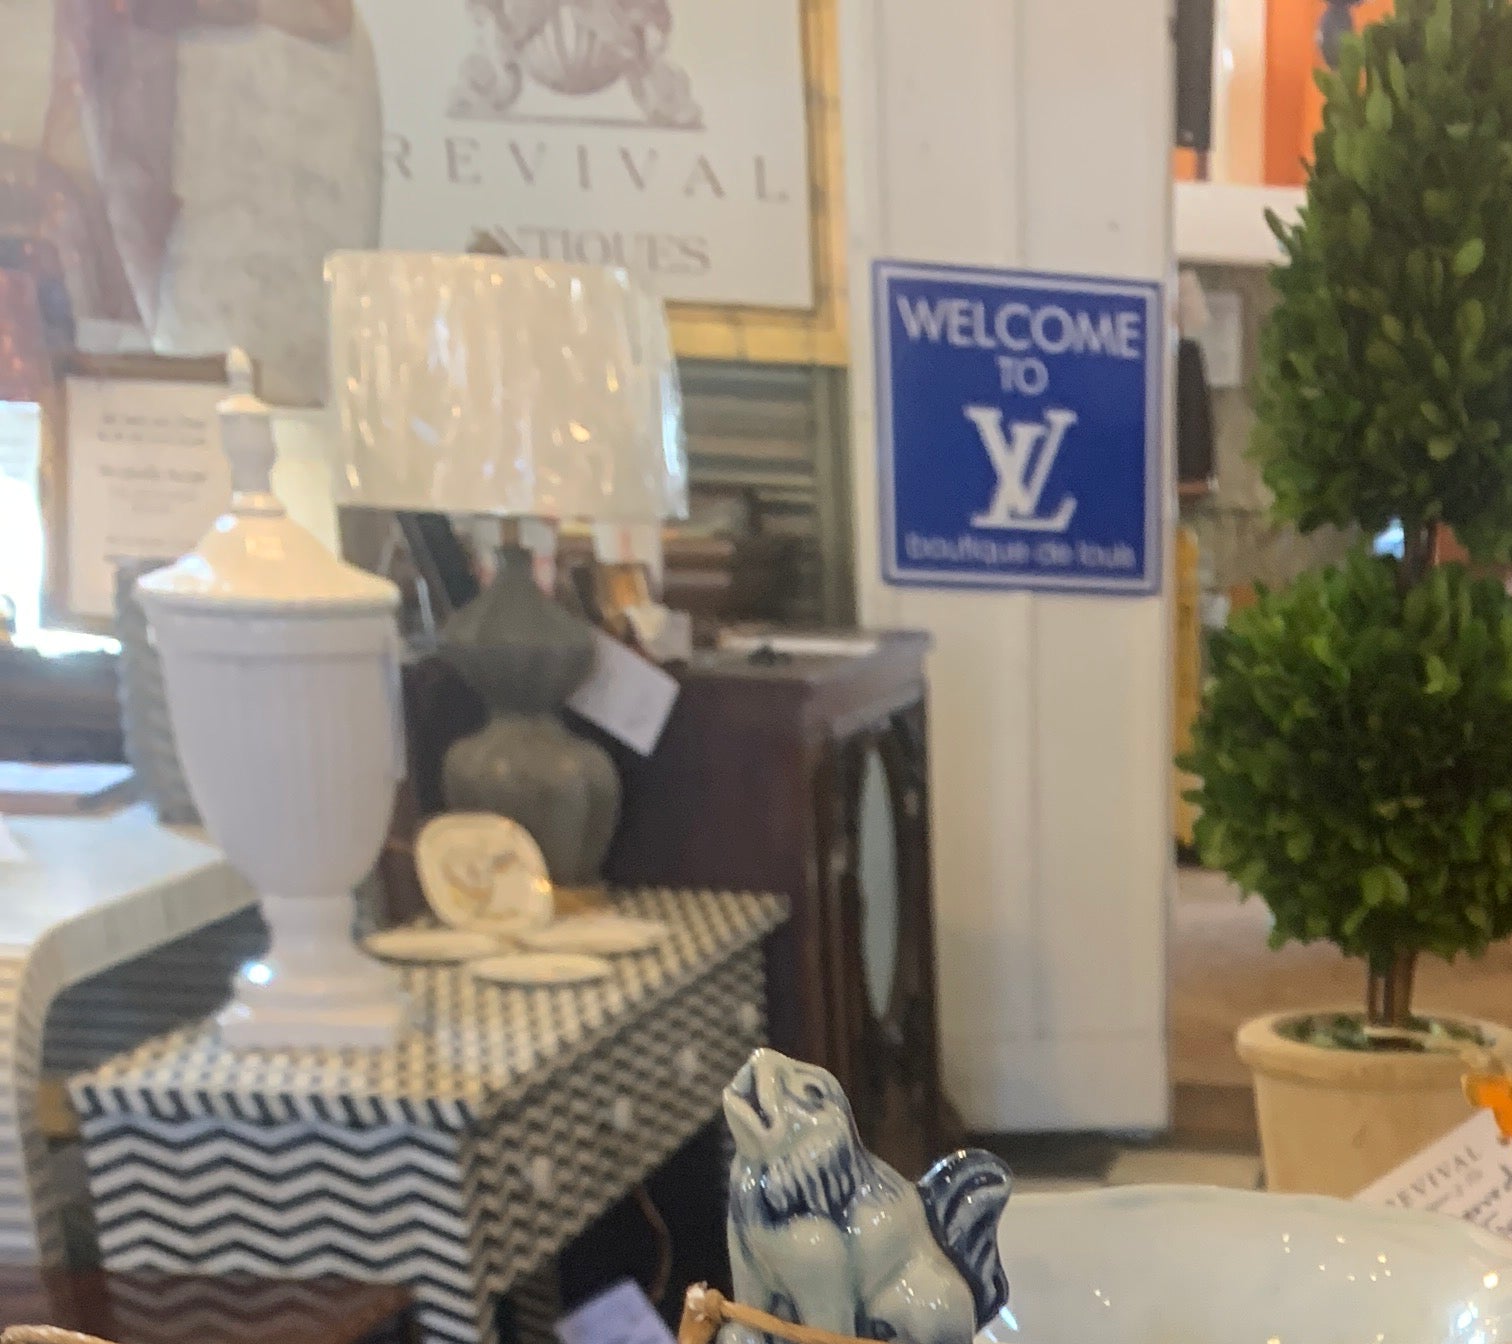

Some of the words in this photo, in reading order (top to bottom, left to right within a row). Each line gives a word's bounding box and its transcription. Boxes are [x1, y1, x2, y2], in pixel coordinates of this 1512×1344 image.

[382, 131, 790, 203] REVIVAL
[897, 296, 1139, 359] WELCOME
[996, 354, 1049, 395] TO
